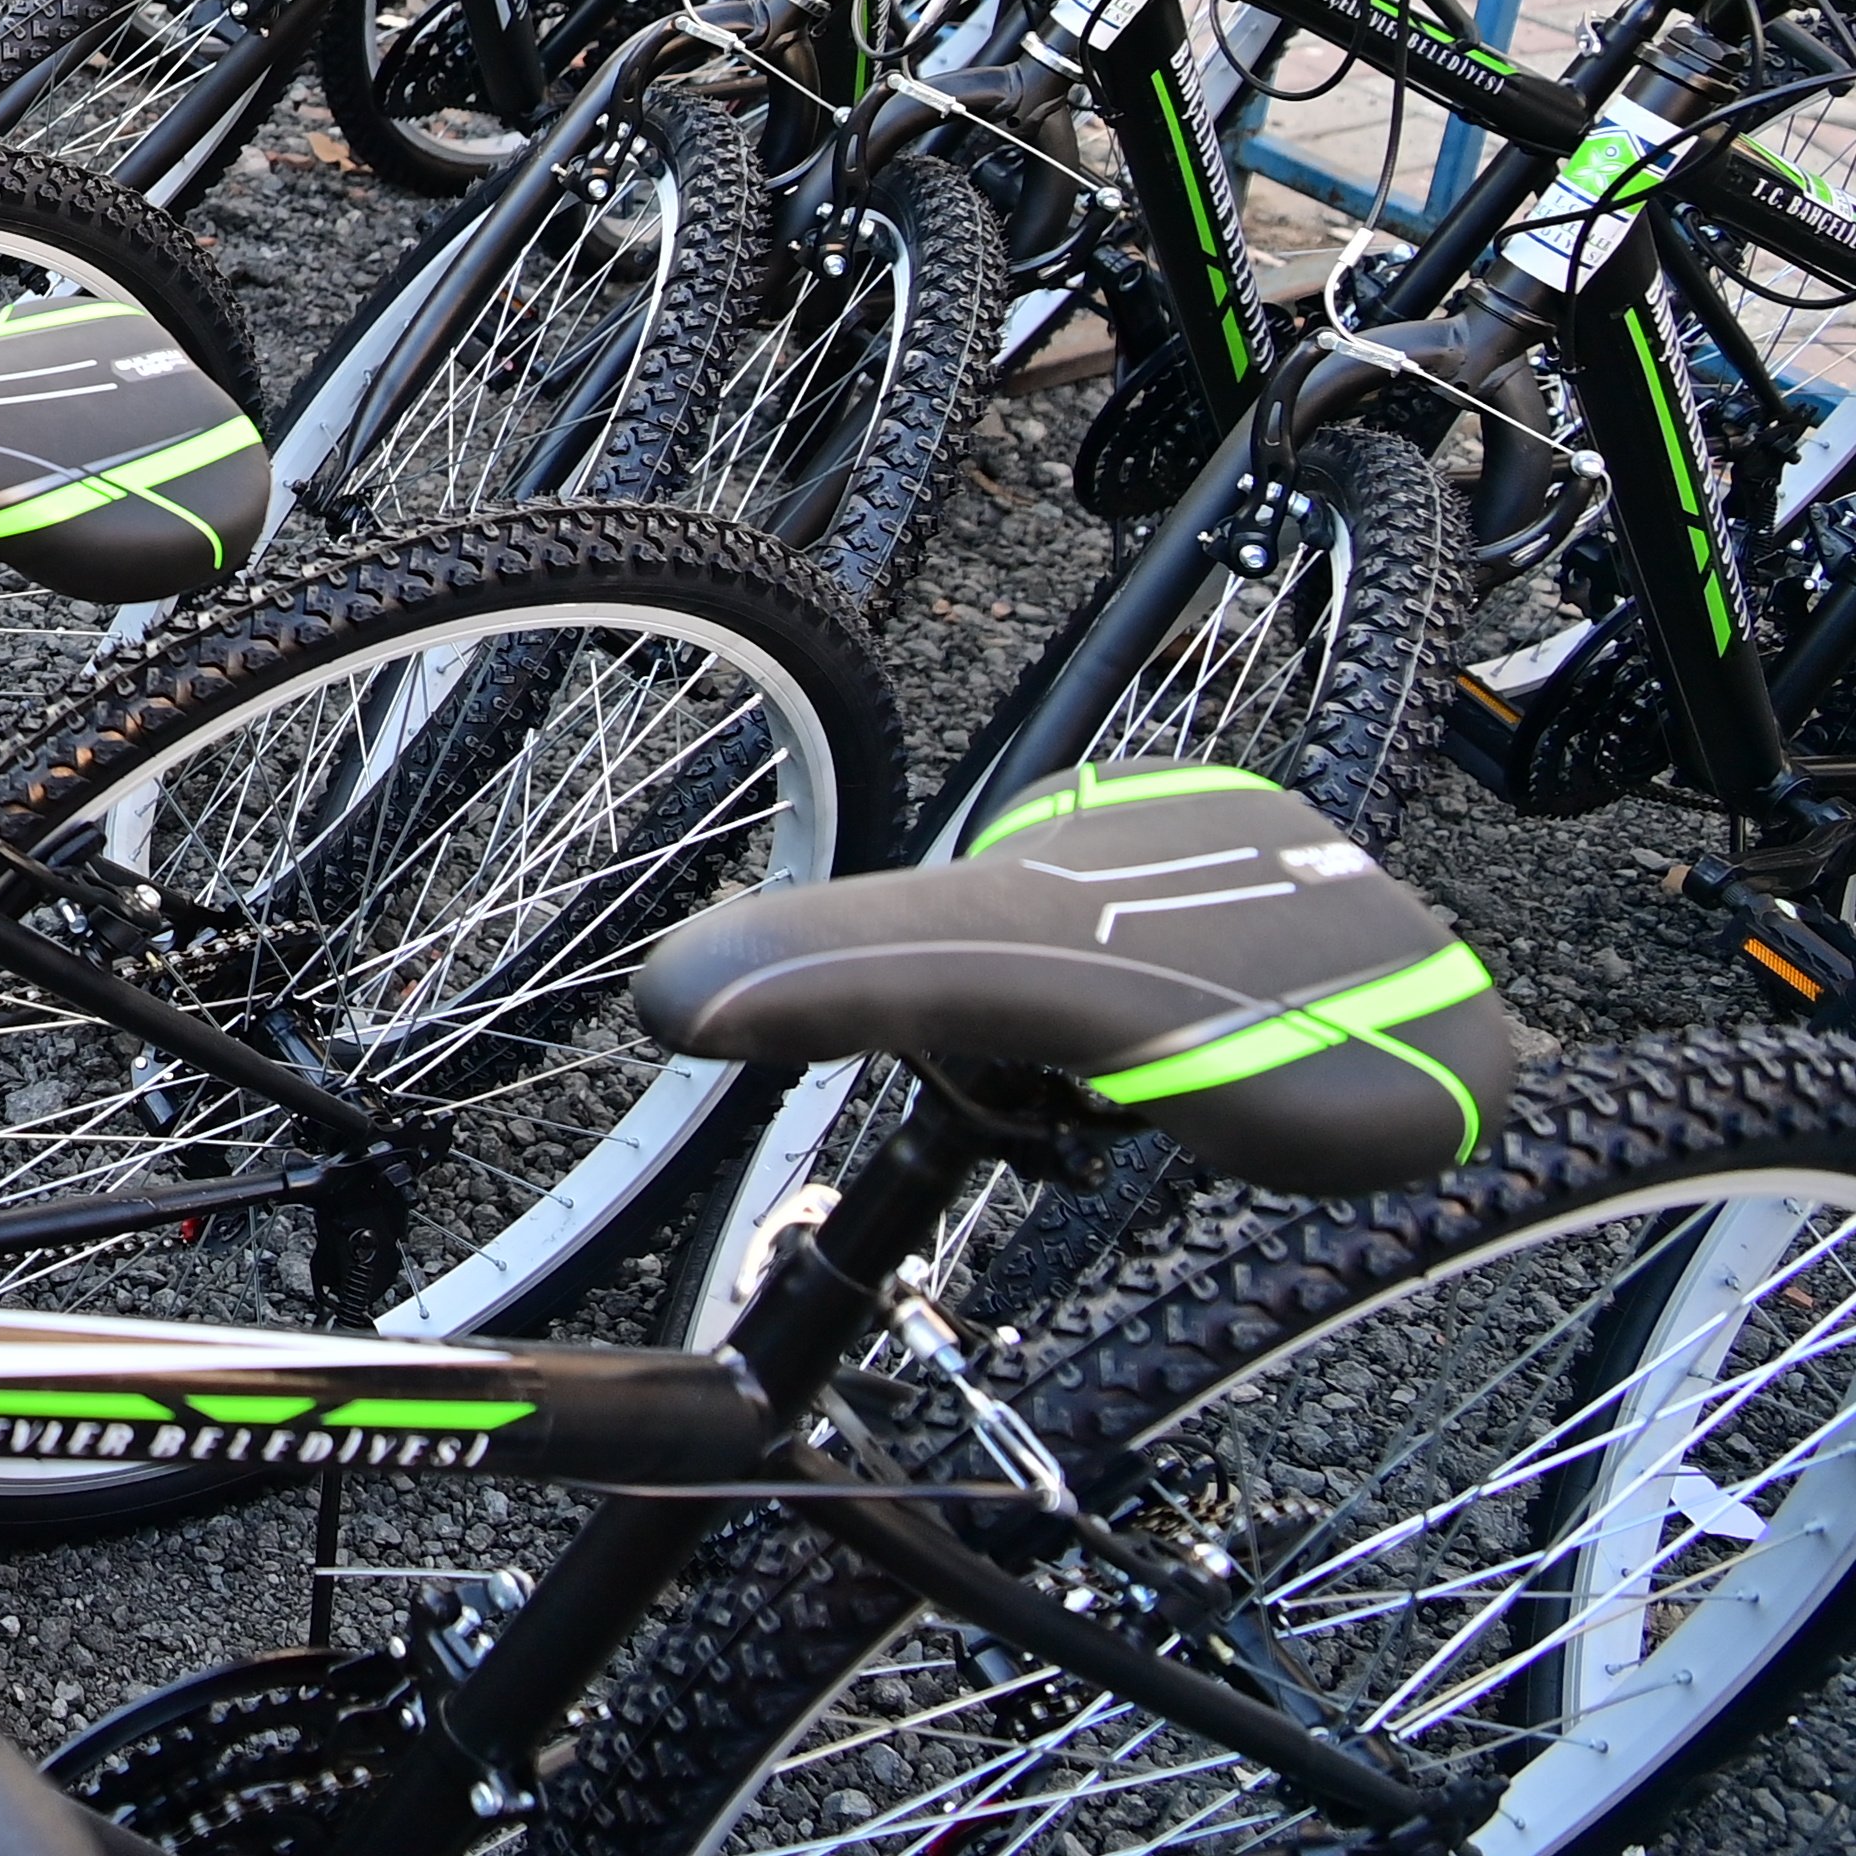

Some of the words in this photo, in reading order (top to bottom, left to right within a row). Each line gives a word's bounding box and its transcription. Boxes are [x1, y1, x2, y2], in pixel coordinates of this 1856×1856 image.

[1406, 33, 1507, 96] BELEDİYESİ
[1751, 177, 1784, 210] T.C.
[148, 1422, 492, 1469] BELEDİYESİ
